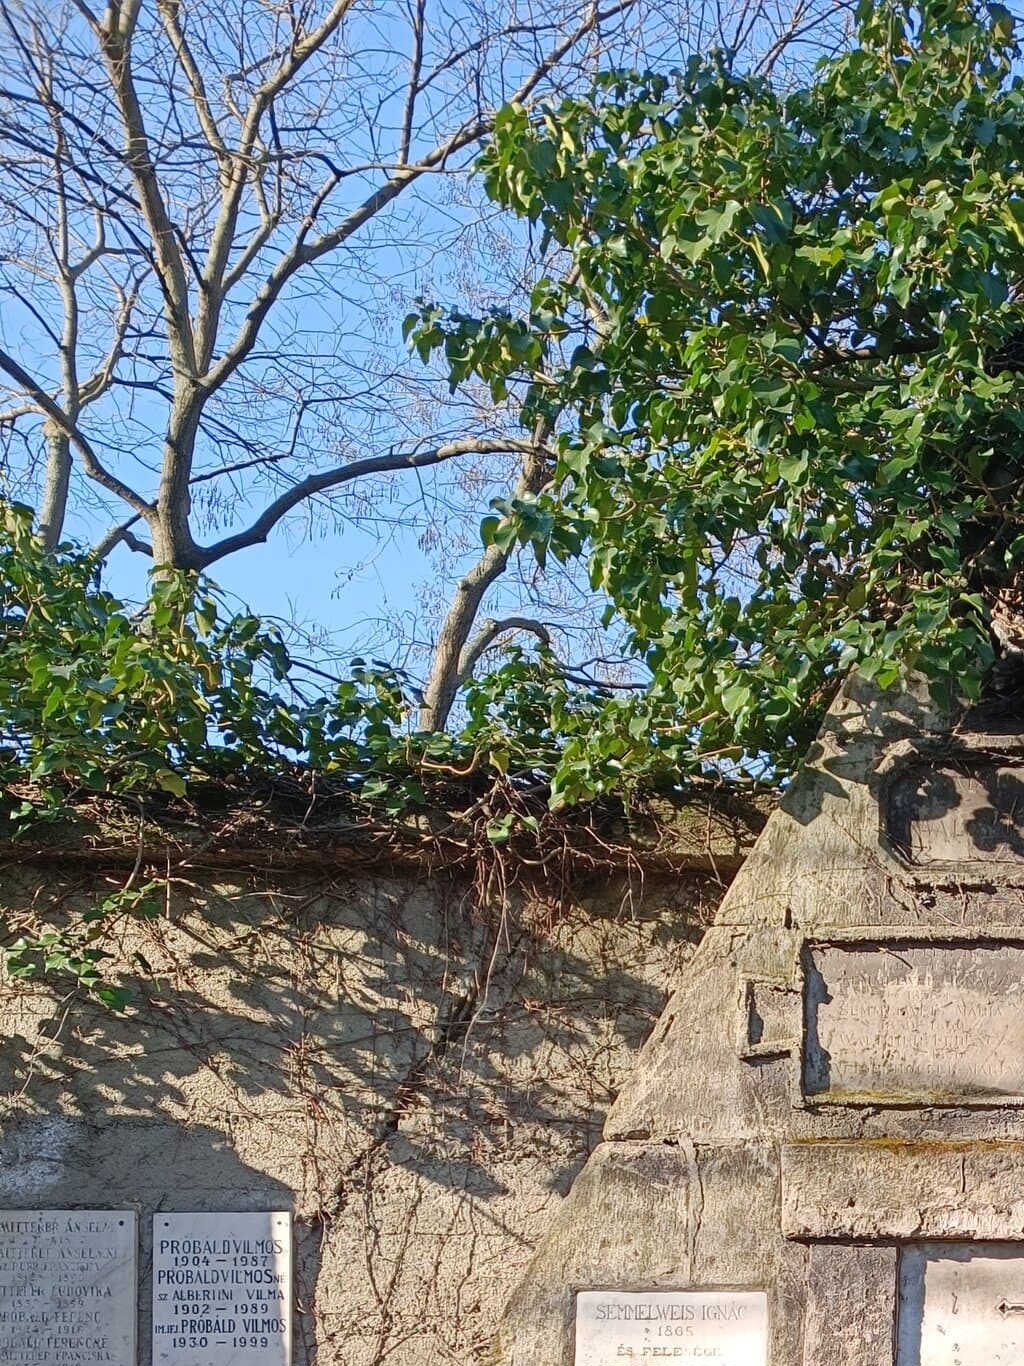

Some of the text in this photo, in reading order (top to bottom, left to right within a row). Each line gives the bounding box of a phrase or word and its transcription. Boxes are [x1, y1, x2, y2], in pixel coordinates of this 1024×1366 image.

[233, 1239, 283, 1255] VILMOS
[174, 1256, 210, 1267] 1904
[233, 1256, 268, 1267] 1987
[246, 1289, 285, 1300] VILMA
[174, 1304, 210, 1315] 1902
[234, 1303, 268, 1314] 1989
[595, 1303, 695, 1321] SEMMELWEIS
[181, 1315, 235, 1334] PRÓBÁLD
[243, 1319, 287, 1334] VILMOS
[173, 1337, 208, 1348] 1930
[233, 1337, 268, 1348] 1999
[616, 1344, 633, 1357] ÉS
